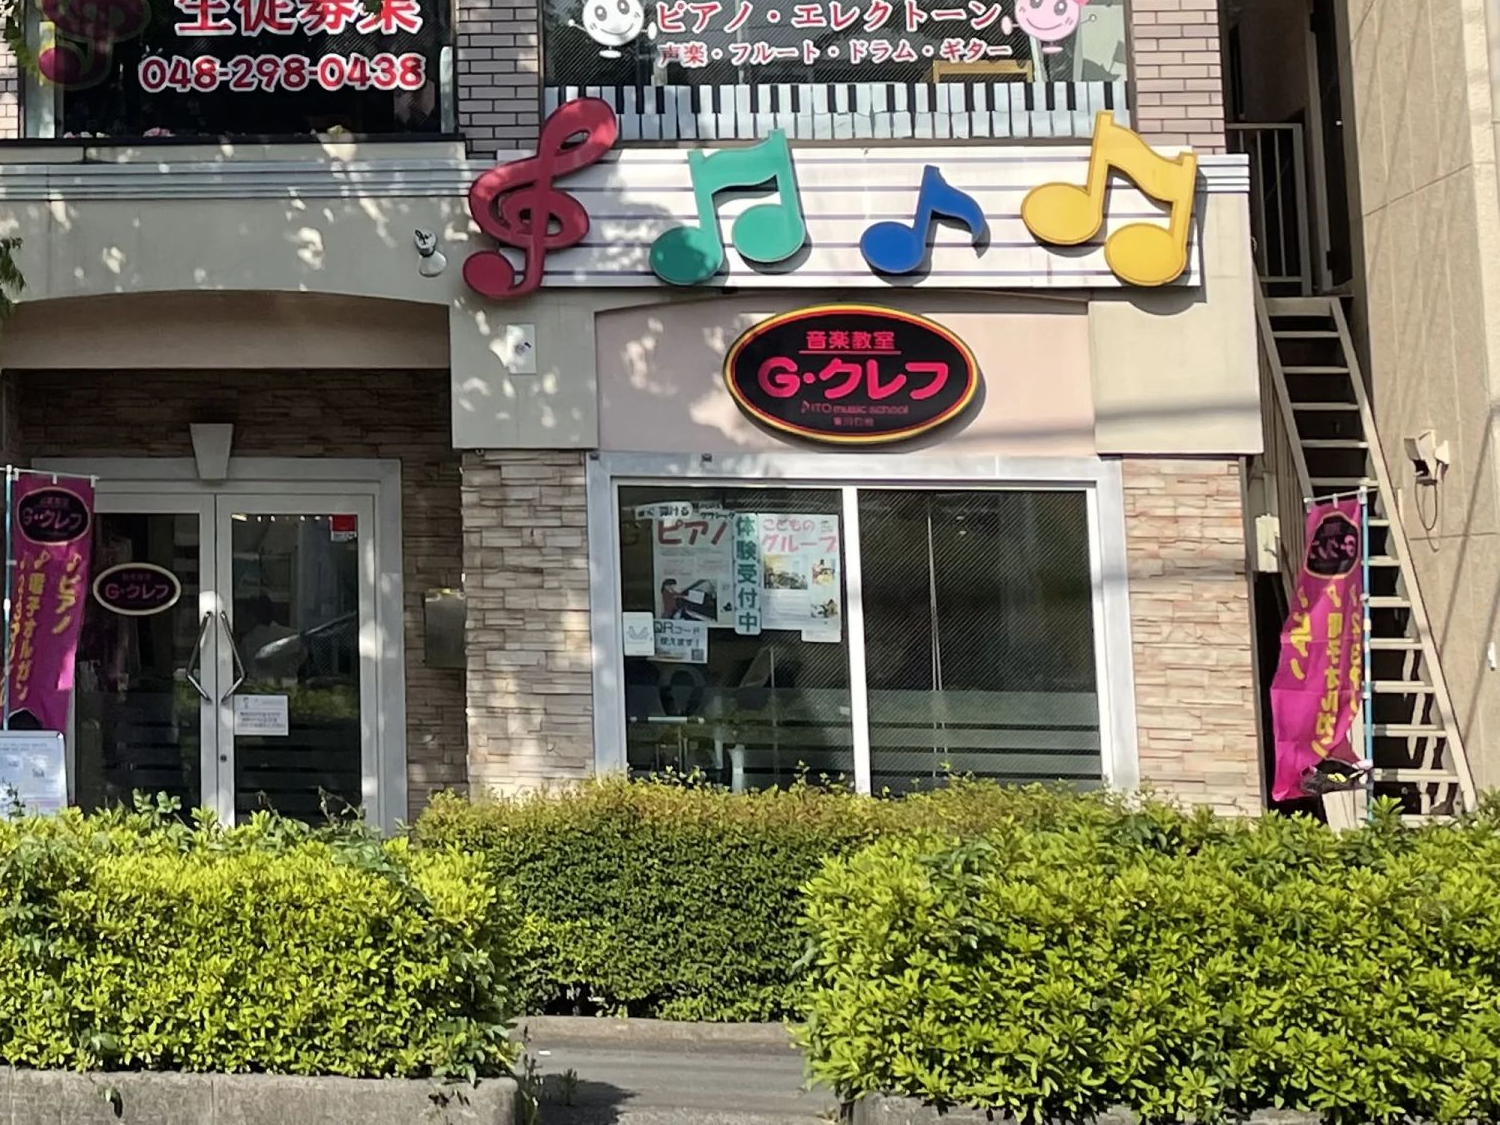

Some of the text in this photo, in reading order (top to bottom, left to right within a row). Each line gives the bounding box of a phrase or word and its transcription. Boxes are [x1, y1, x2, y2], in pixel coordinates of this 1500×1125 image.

[656, 41, 1013, 68] 声楽・フルート・ドラム・ギター
[138, 53, 426, 93] 048-298-0438
[806, 331, 895, 350] 音楽教室
[757, 356, 949, 400] G・クレフ
[833, 404, 867, 414] music
[869, 404, 909, 415] school
[658, 519, 728, 545] ピアノ
[763, 518, 815, 532] こどもの
[735, 516, 757, 632] 体験受付中
[105, 583, 169, 600] G・クレフ
